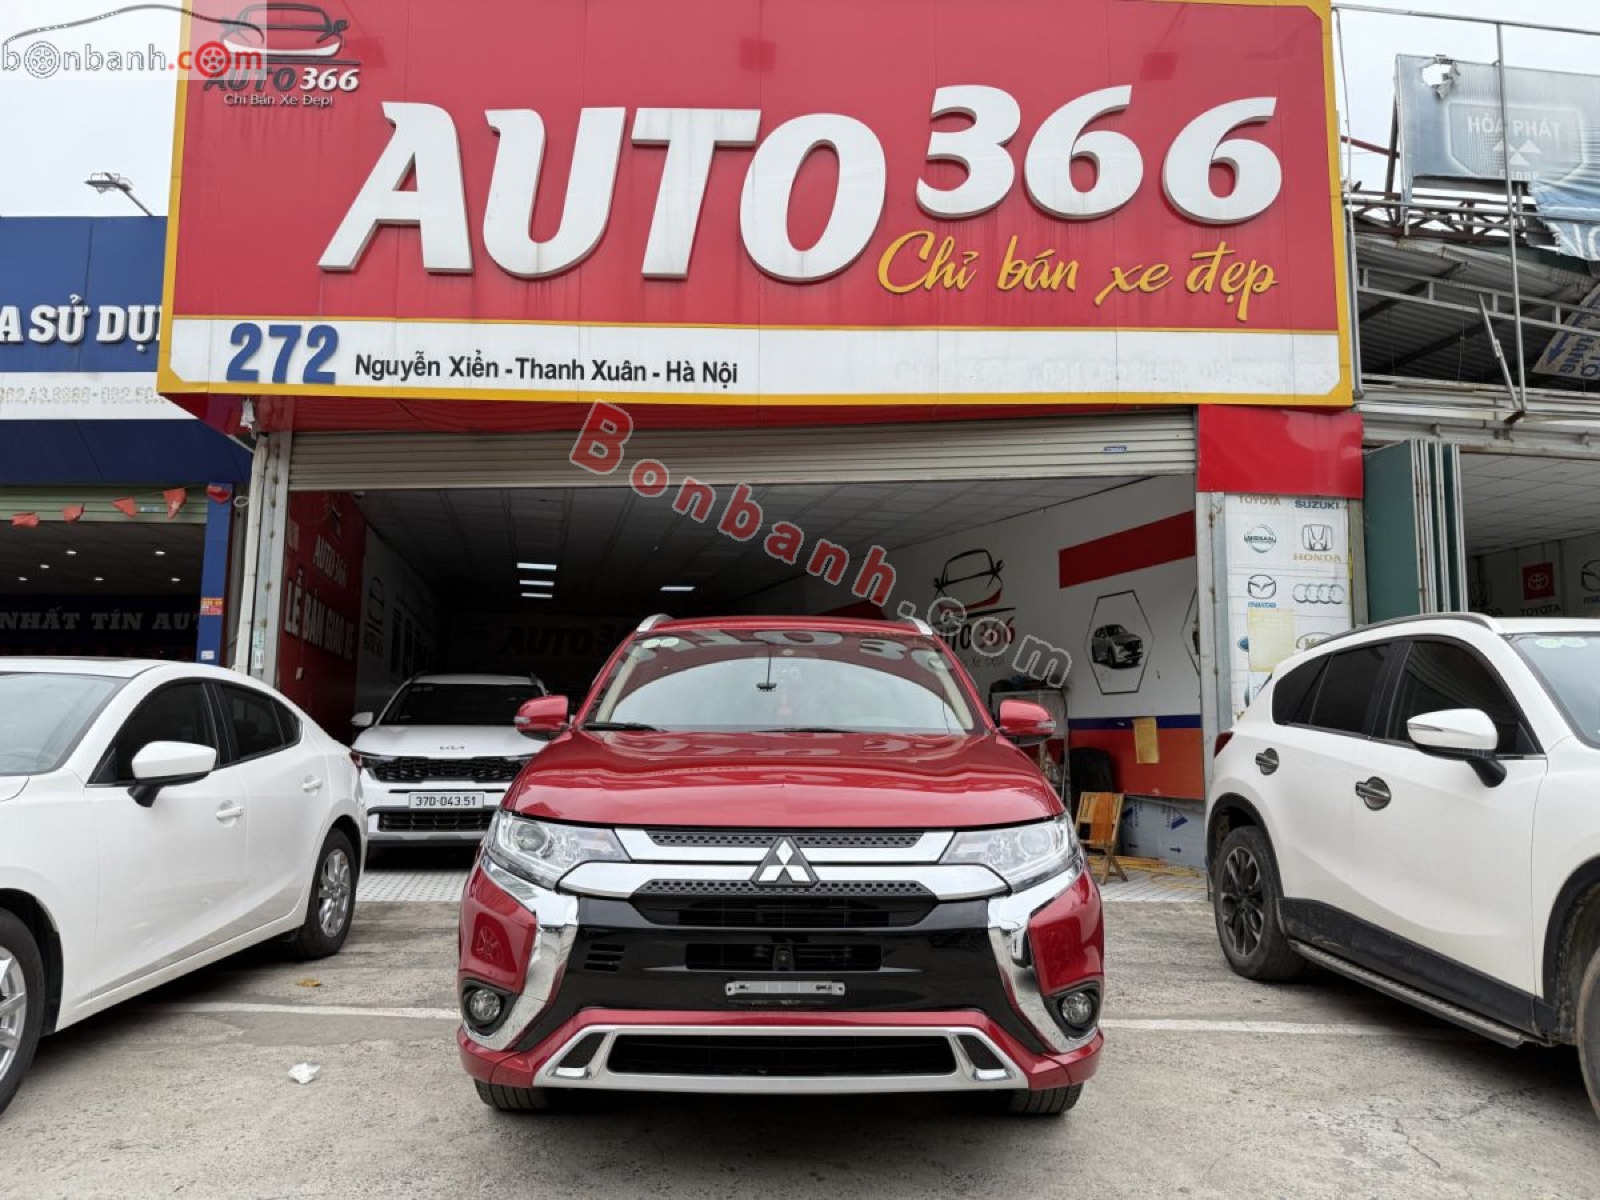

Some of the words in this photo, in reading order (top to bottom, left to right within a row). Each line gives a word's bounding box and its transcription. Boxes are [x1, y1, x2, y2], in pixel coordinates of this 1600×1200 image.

[300, 67, 360, 91] 366
[250, 93, 276, 106] Bán
[279, 94, 299, 106] Xe
[317, 100, 887, 284] AUTO
[915, 84, 1283, 226] 366
[877, 230, 979, 294] Chỉ
[996, 235, 1079, 292] bán
[1094, 260, 1174, 308] xe
[1185, 240, 1279, 322] đẹp
[29, 293, 91, 344] SỬ
[225, 322, 340, 386] 272
[355, 350, 441, 382] Nguyễn
[448, 349, 499, 379] Xiển
[516, 357, 585, 381] Thanh
[591, 358, 646, 382] Xuân
[666, 360, 696, 384] Hà
[703, 360, 739, 389] Nội
[1238, 494, 1281, 506] TOYOTA
[1294, 500, 1340, 510] SUZUKI
[1293, 553, 1342, 562] HONDA
[91, 608, 142, 631] TÍN
[152, 611, 200, 631] AU
[1519, 604, 1561, 617] TOYOTA
